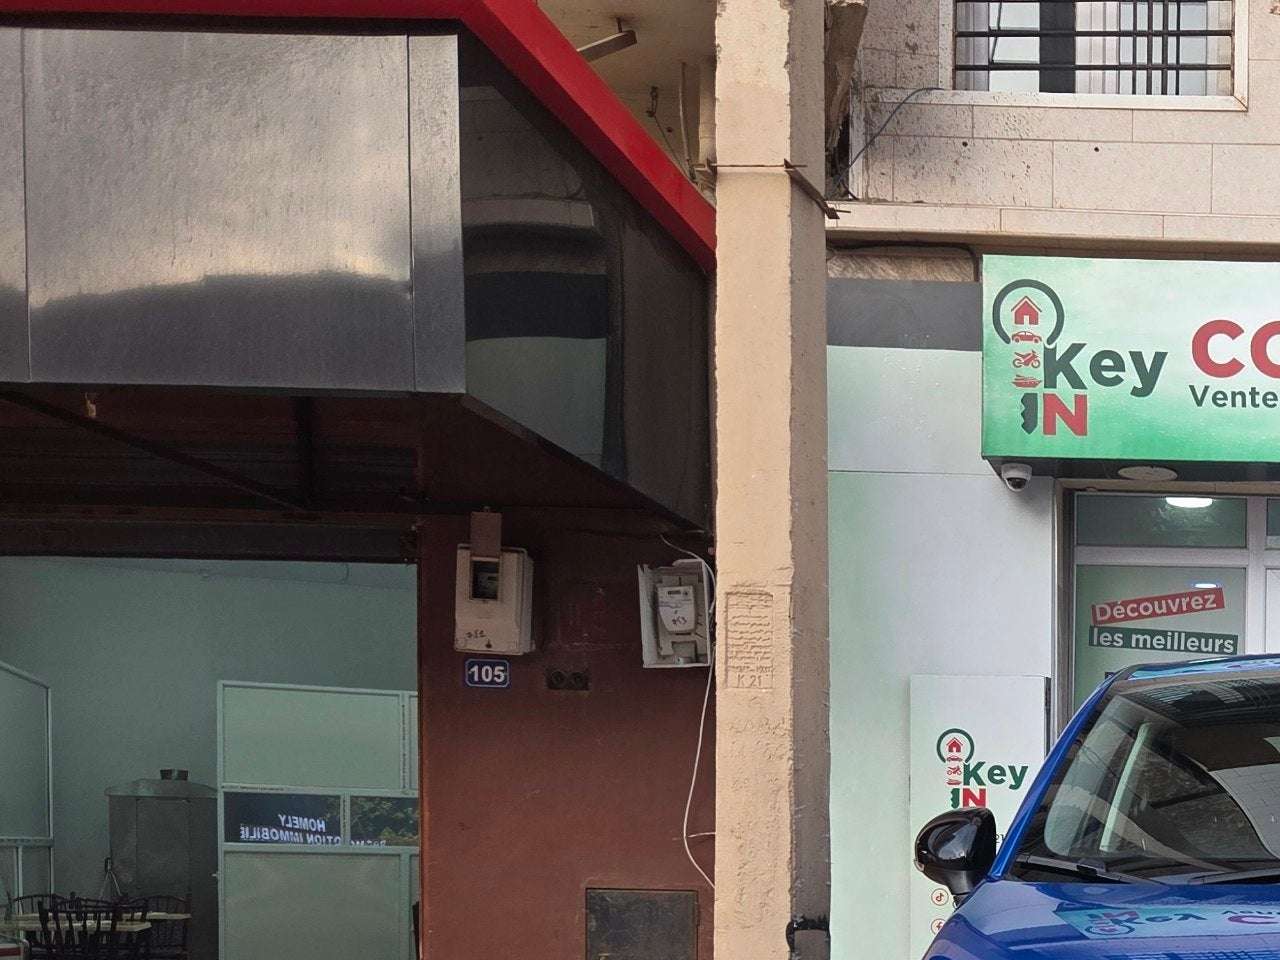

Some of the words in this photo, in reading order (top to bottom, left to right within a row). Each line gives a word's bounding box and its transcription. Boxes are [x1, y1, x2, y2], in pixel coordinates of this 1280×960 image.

[1043, 342, 1168, 397] Key
[1189, 384, 1278, 408] Vente
[1094, 591, 1217, 621] Découvrez
[1093, 627, 1123, 647] les
[1131, 632, 1234, 653] meilleurs
[468, 665, 505, 683] 105
[963, 761, 1029, 790] Key
